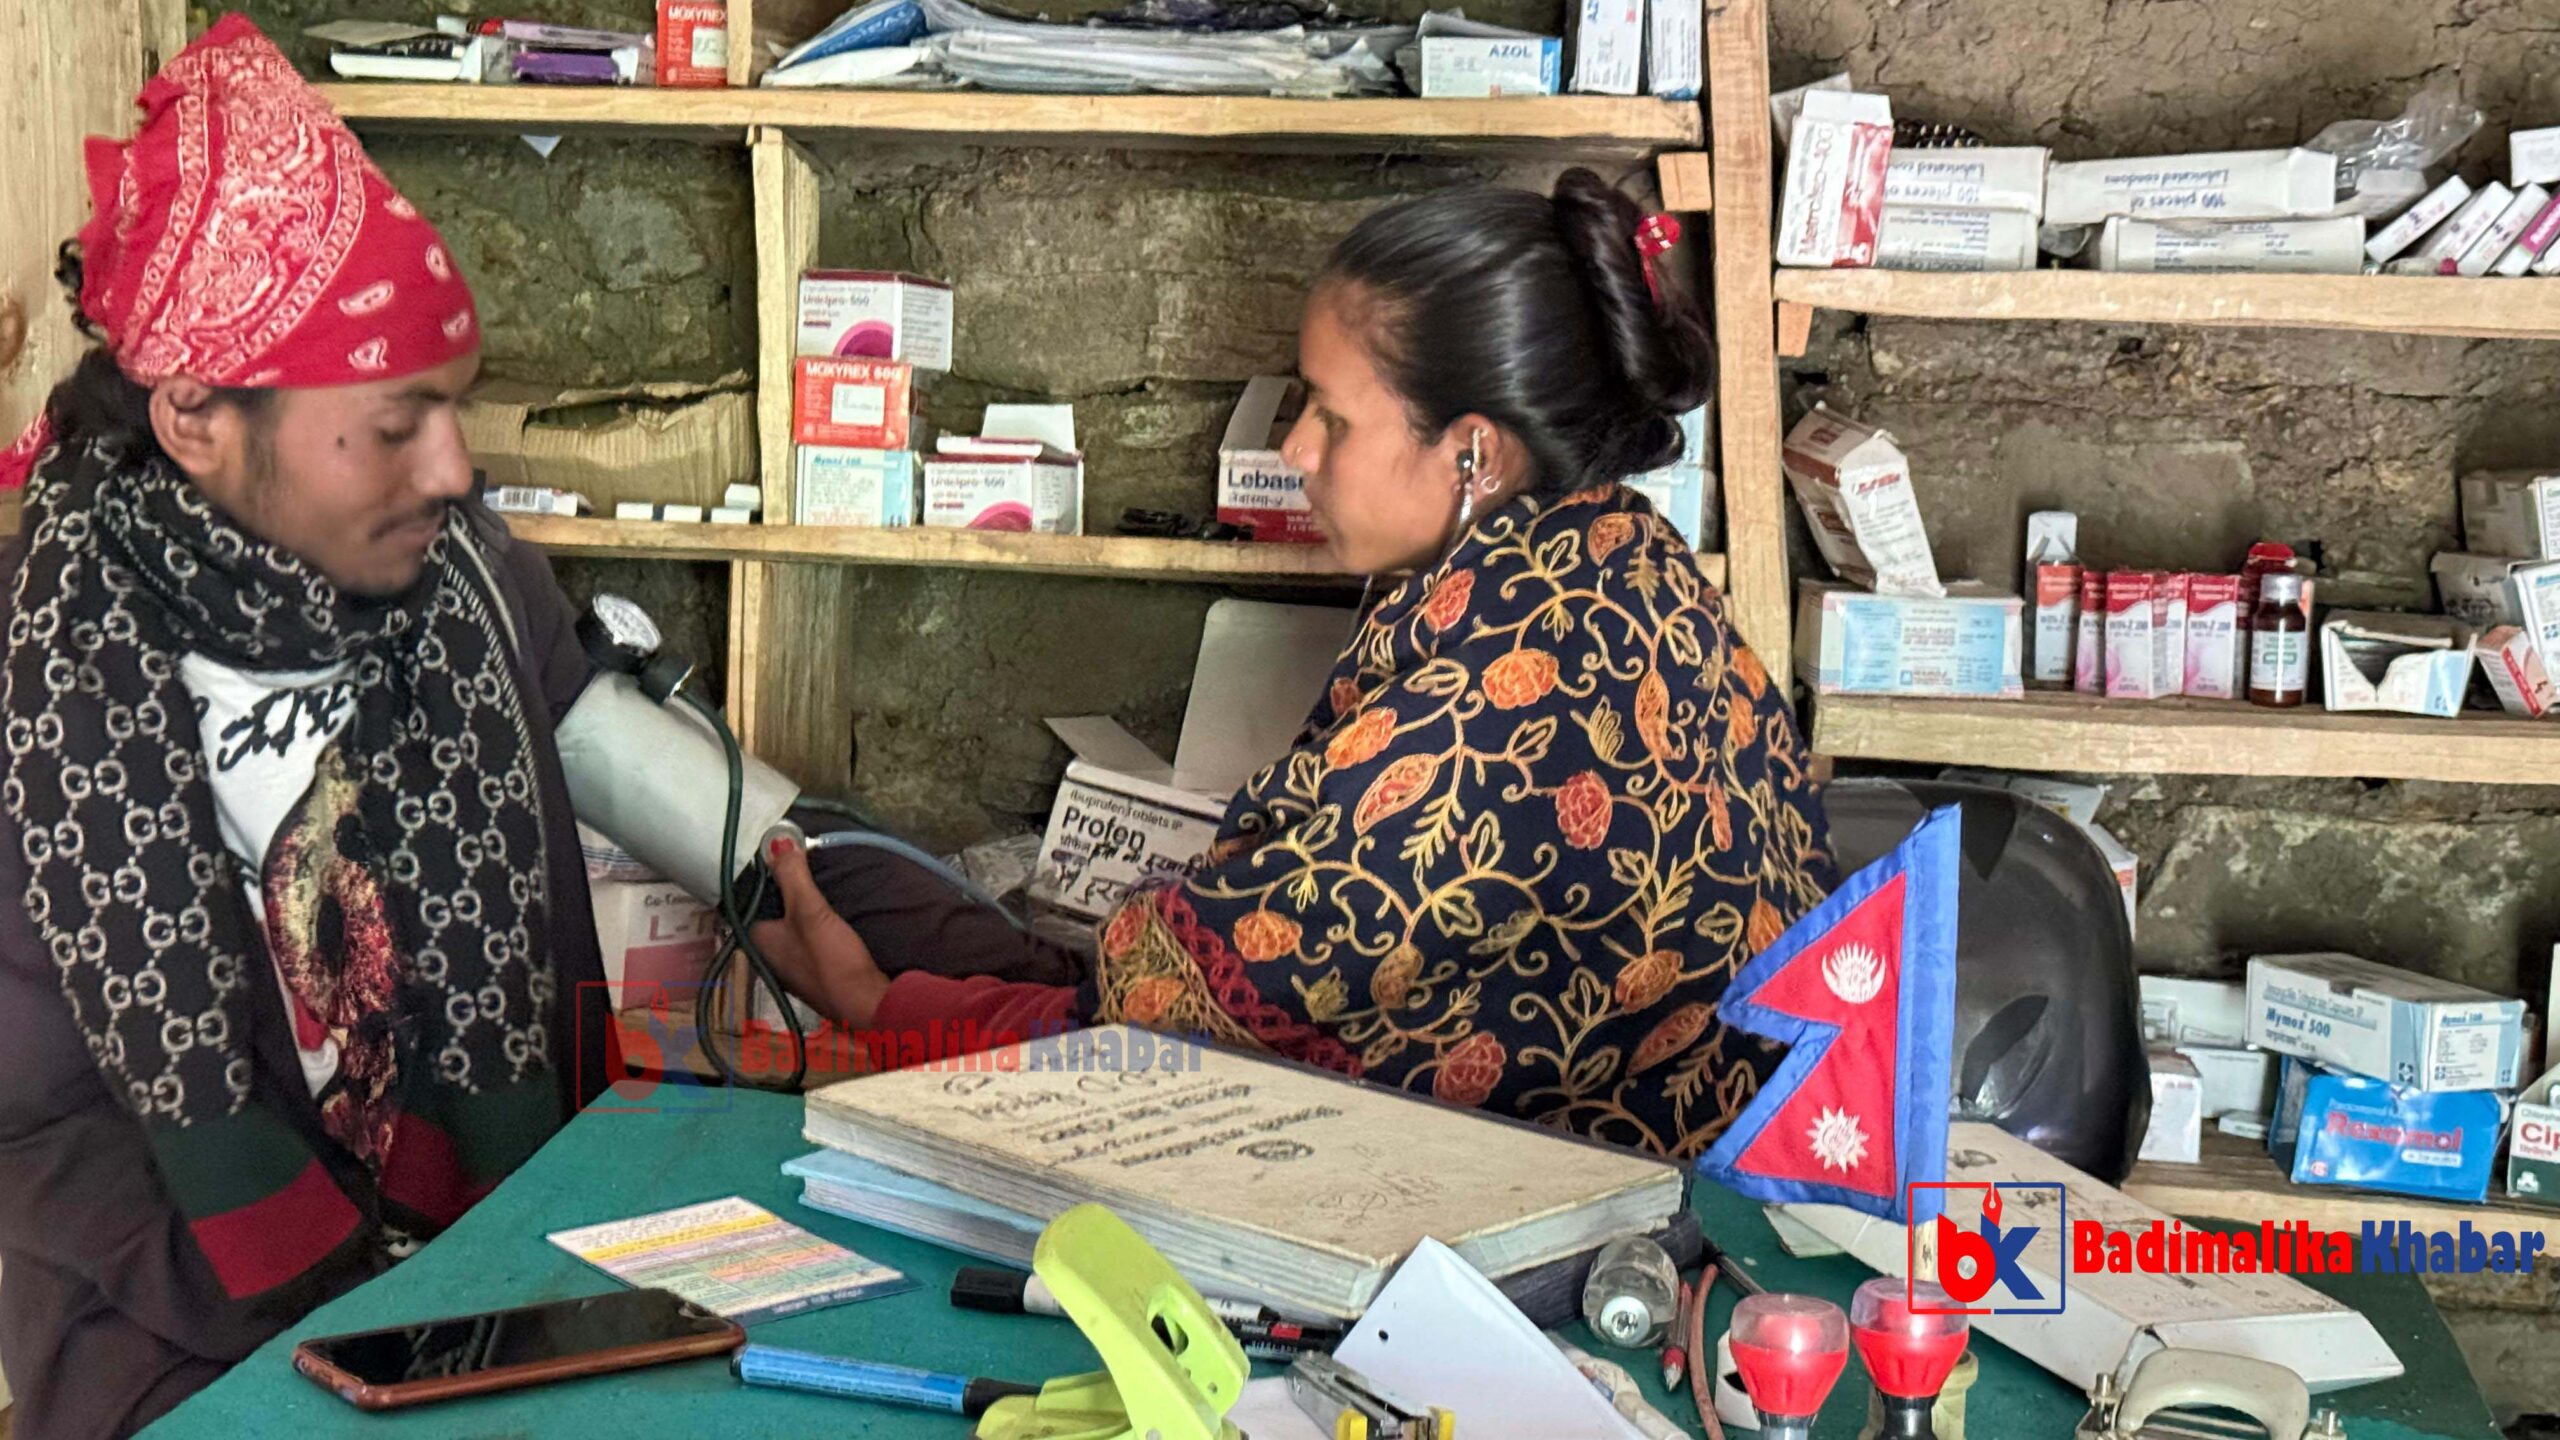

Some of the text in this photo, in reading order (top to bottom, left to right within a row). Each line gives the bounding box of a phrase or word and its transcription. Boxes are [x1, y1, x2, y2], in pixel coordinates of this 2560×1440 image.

[1489, 44, 1532, 58] AZOL
[2105, 168, 2229, 188] Lubricated condoms
[2149, 191, 2197, 208] pieces
[1062, 806, 1146, 849] Profen
[2266, 1007, 2331, 1038] Mymox 500
